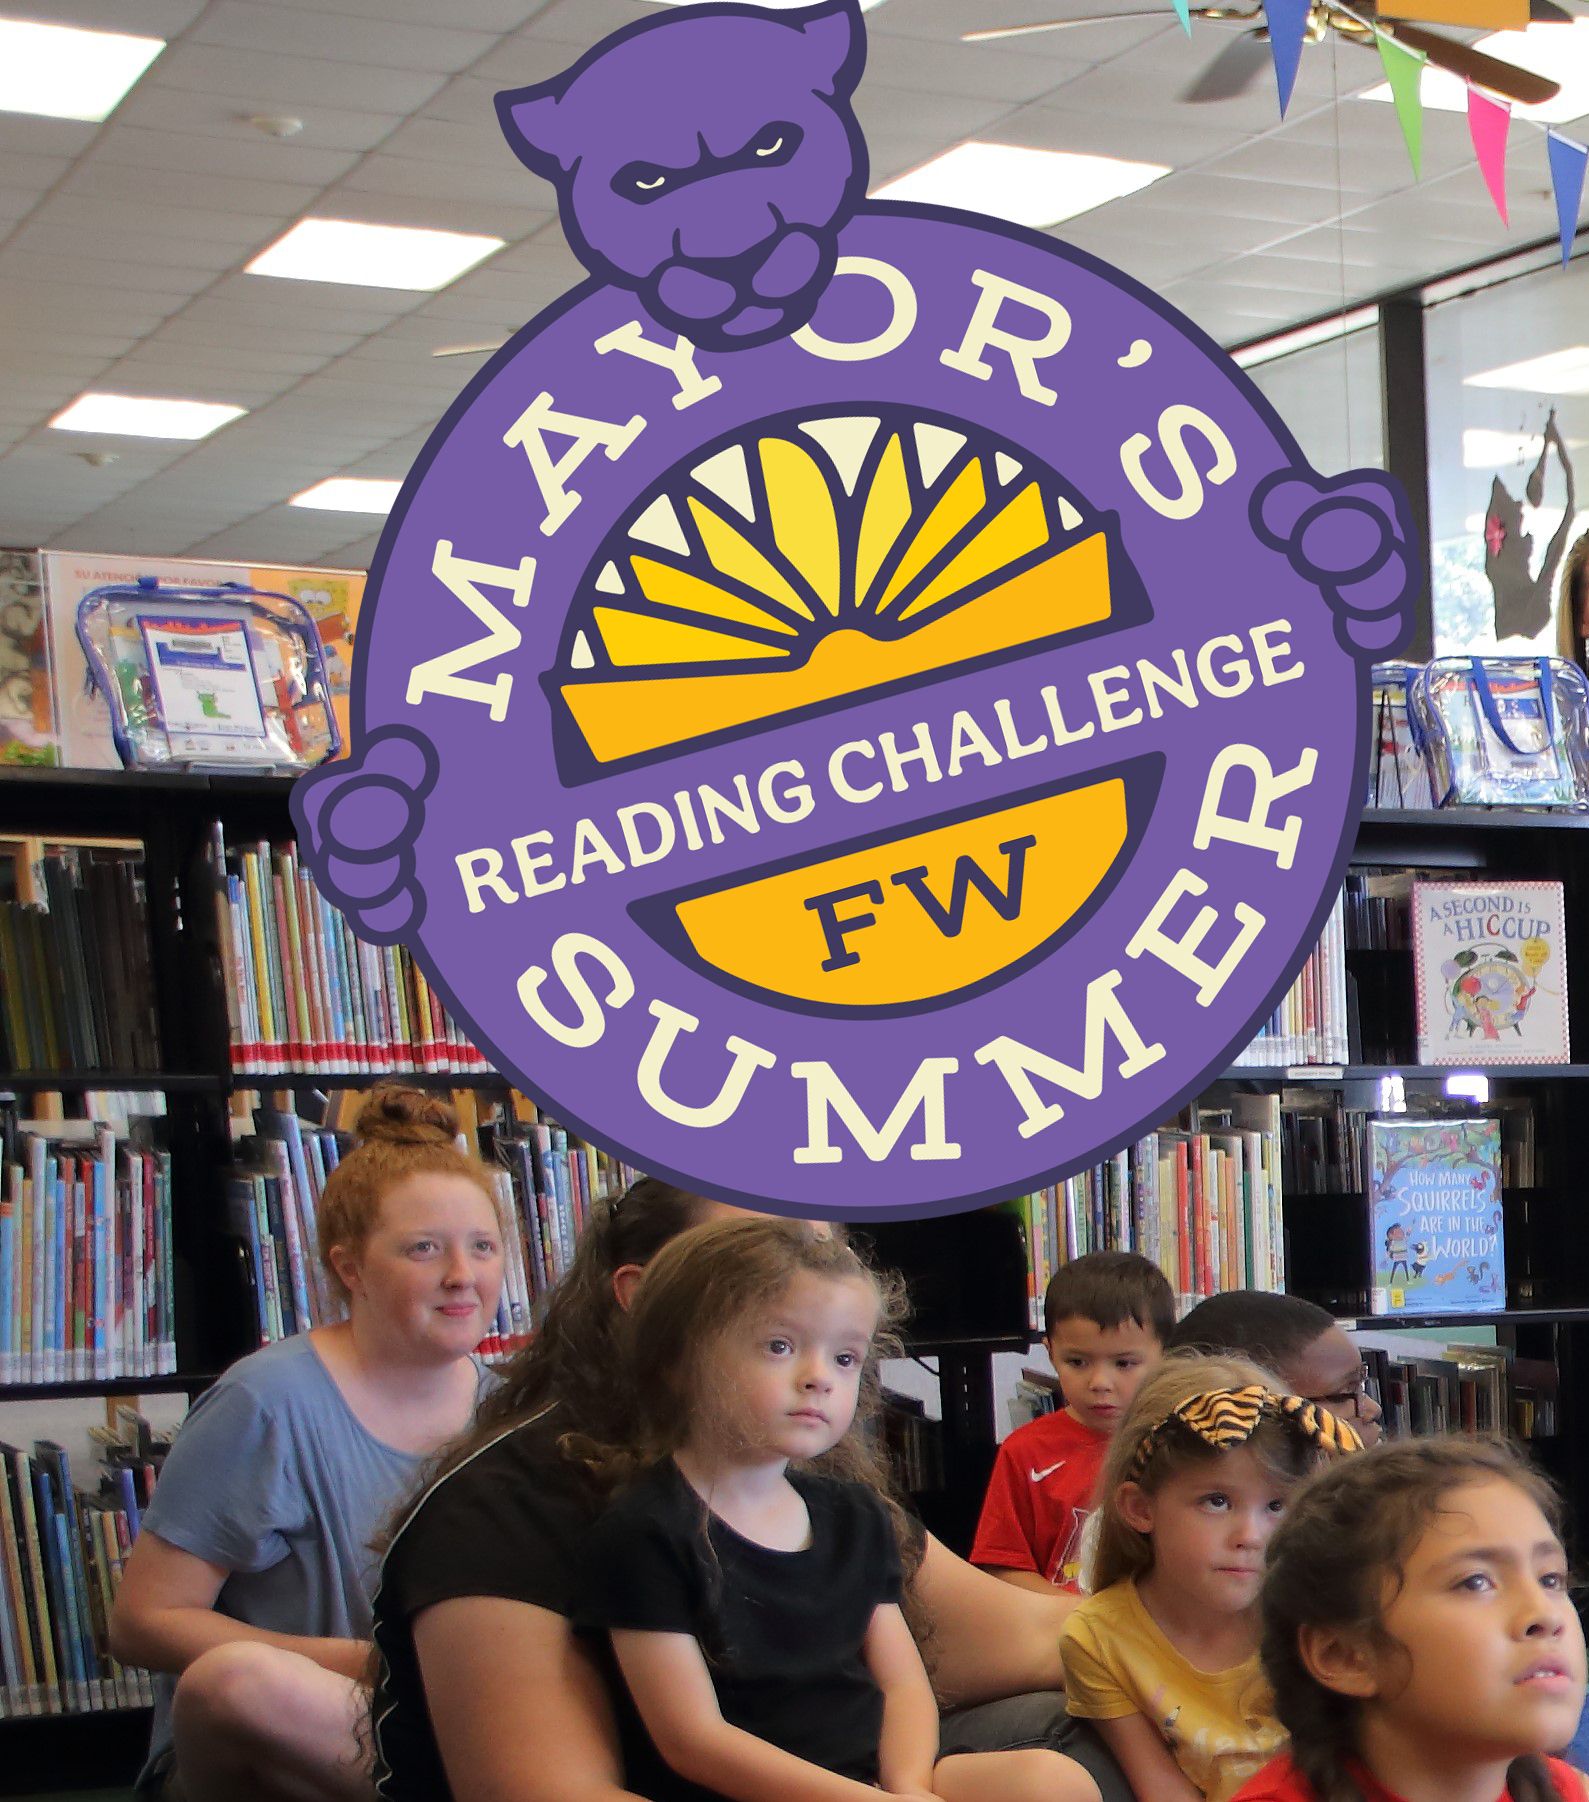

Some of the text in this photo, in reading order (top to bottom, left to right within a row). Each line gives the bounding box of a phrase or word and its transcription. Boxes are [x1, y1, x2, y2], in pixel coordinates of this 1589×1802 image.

[1430, 896, 1531, 922] A SECOND IS
[1443, 913, 1551, 942] A HICCUP
[1410, 1170, 1472, 1187] HOW MANY
[1398, 1186, 1487, 1217] SQUIRRELS
[1420, 1215, 1486, 1234] ARE IN THE
[1431, 1234, 1498, 1261] WORLD?
